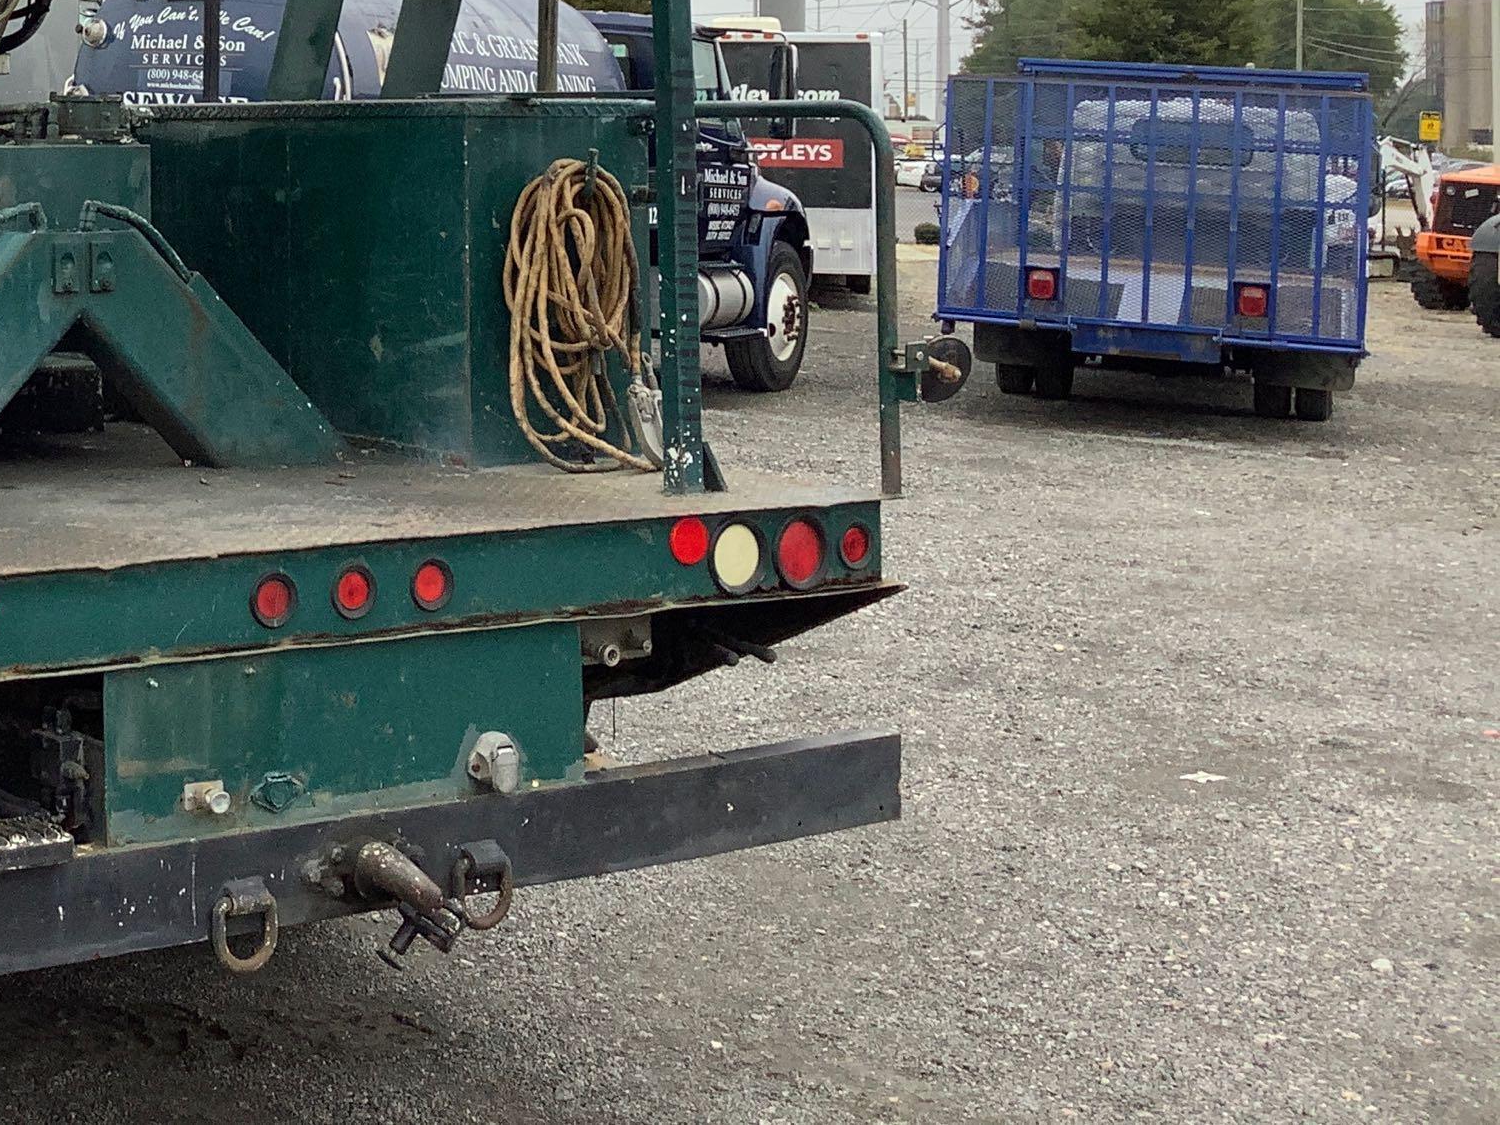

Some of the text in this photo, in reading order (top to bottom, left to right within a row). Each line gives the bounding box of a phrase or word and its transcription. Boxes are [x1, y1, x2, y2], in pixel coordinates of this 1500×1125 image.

[113, 22, 125, 40] If
[129, 13, 154, 32] You
[232, 17, 276, 41] Can!
[131, 34, 245, 52] Michael & Son
[473, 32, 491, 56] &
[486, 34, 538, 61] GREAS
[556, 42, 589, 66] ANK
[142, 53, 227, 67] SERVICS
[147, 68, 204, 81] (800) 948-64
[441, 63, 596, 92] UMPING AND CANING
[748, 143, 833, 161] OTLEYS
[704, 168, 728, 184] Michael
[709, 188, 742, 200] SERVICES
